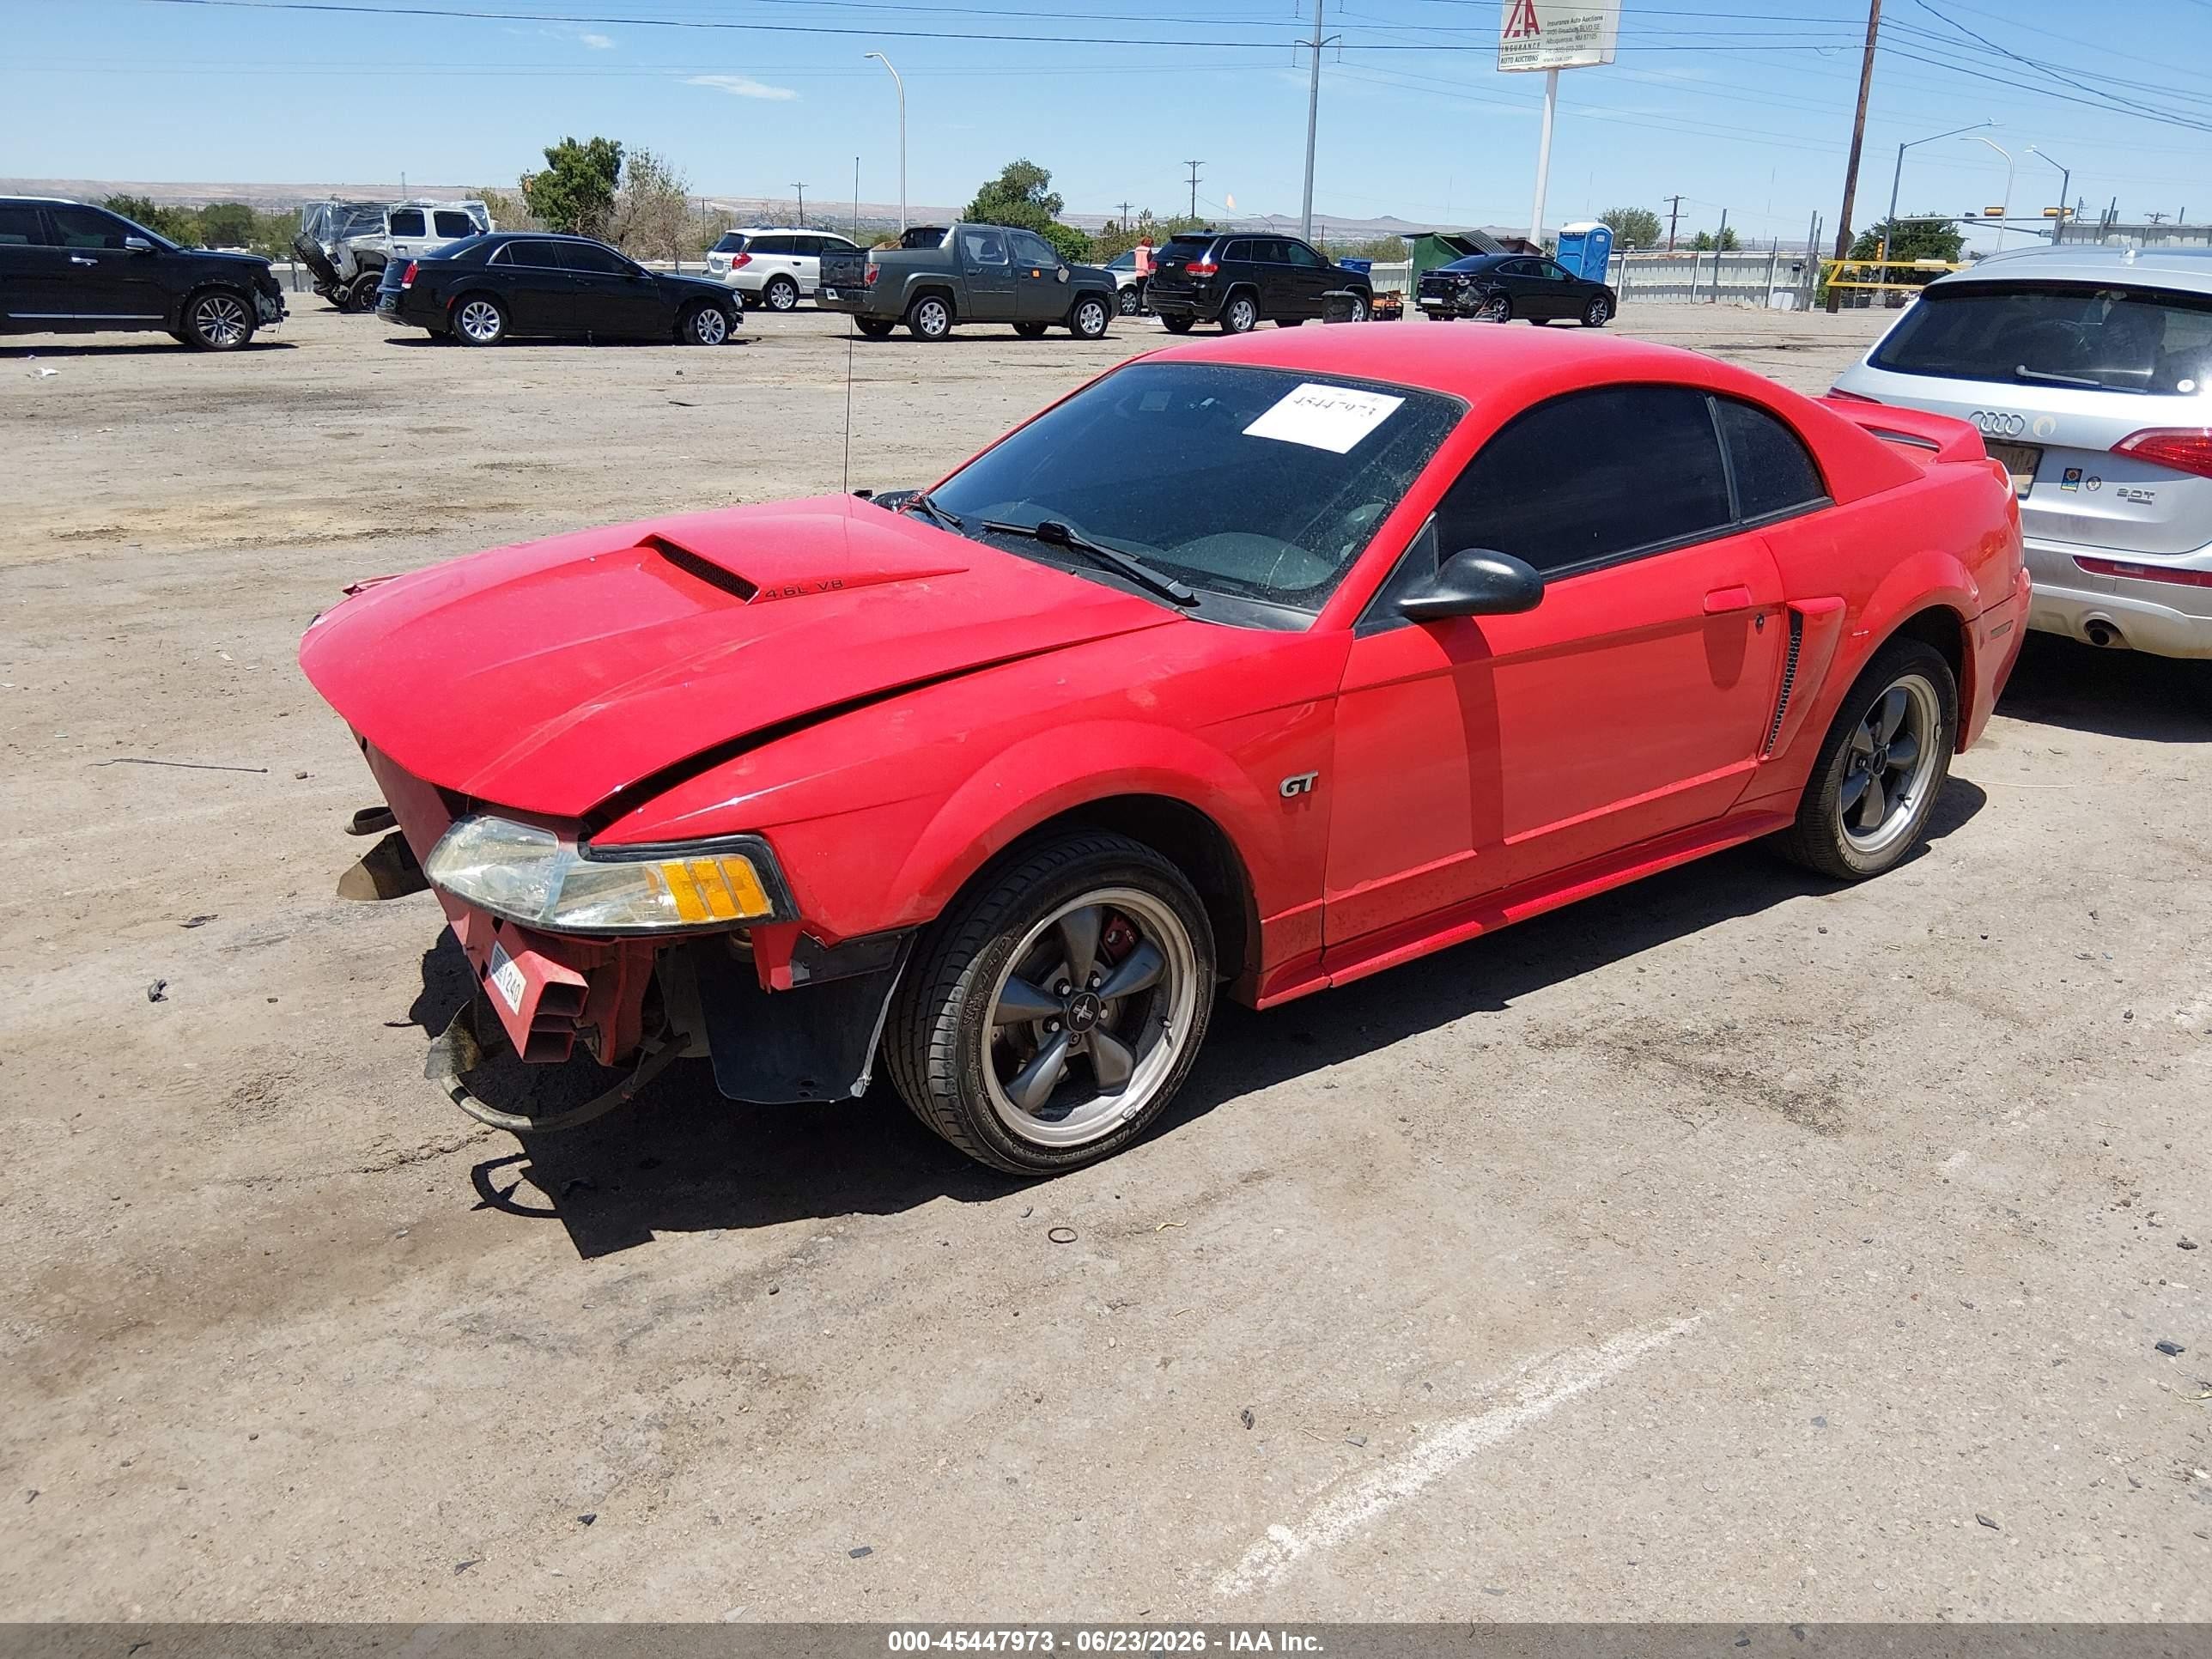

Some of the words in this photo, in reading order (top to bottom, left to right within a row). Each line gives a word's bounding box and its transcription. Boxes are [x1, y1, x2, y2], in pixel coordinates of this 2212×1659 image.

[1501, 42, 1540, 52] INSURANCE
[1515, 54, 1539, 63] AUCTIONS
[765, 586, 809, 599] 4.6L
[817, 579, 844, 591] V8
[1278, 770, 1319, 798] GT
